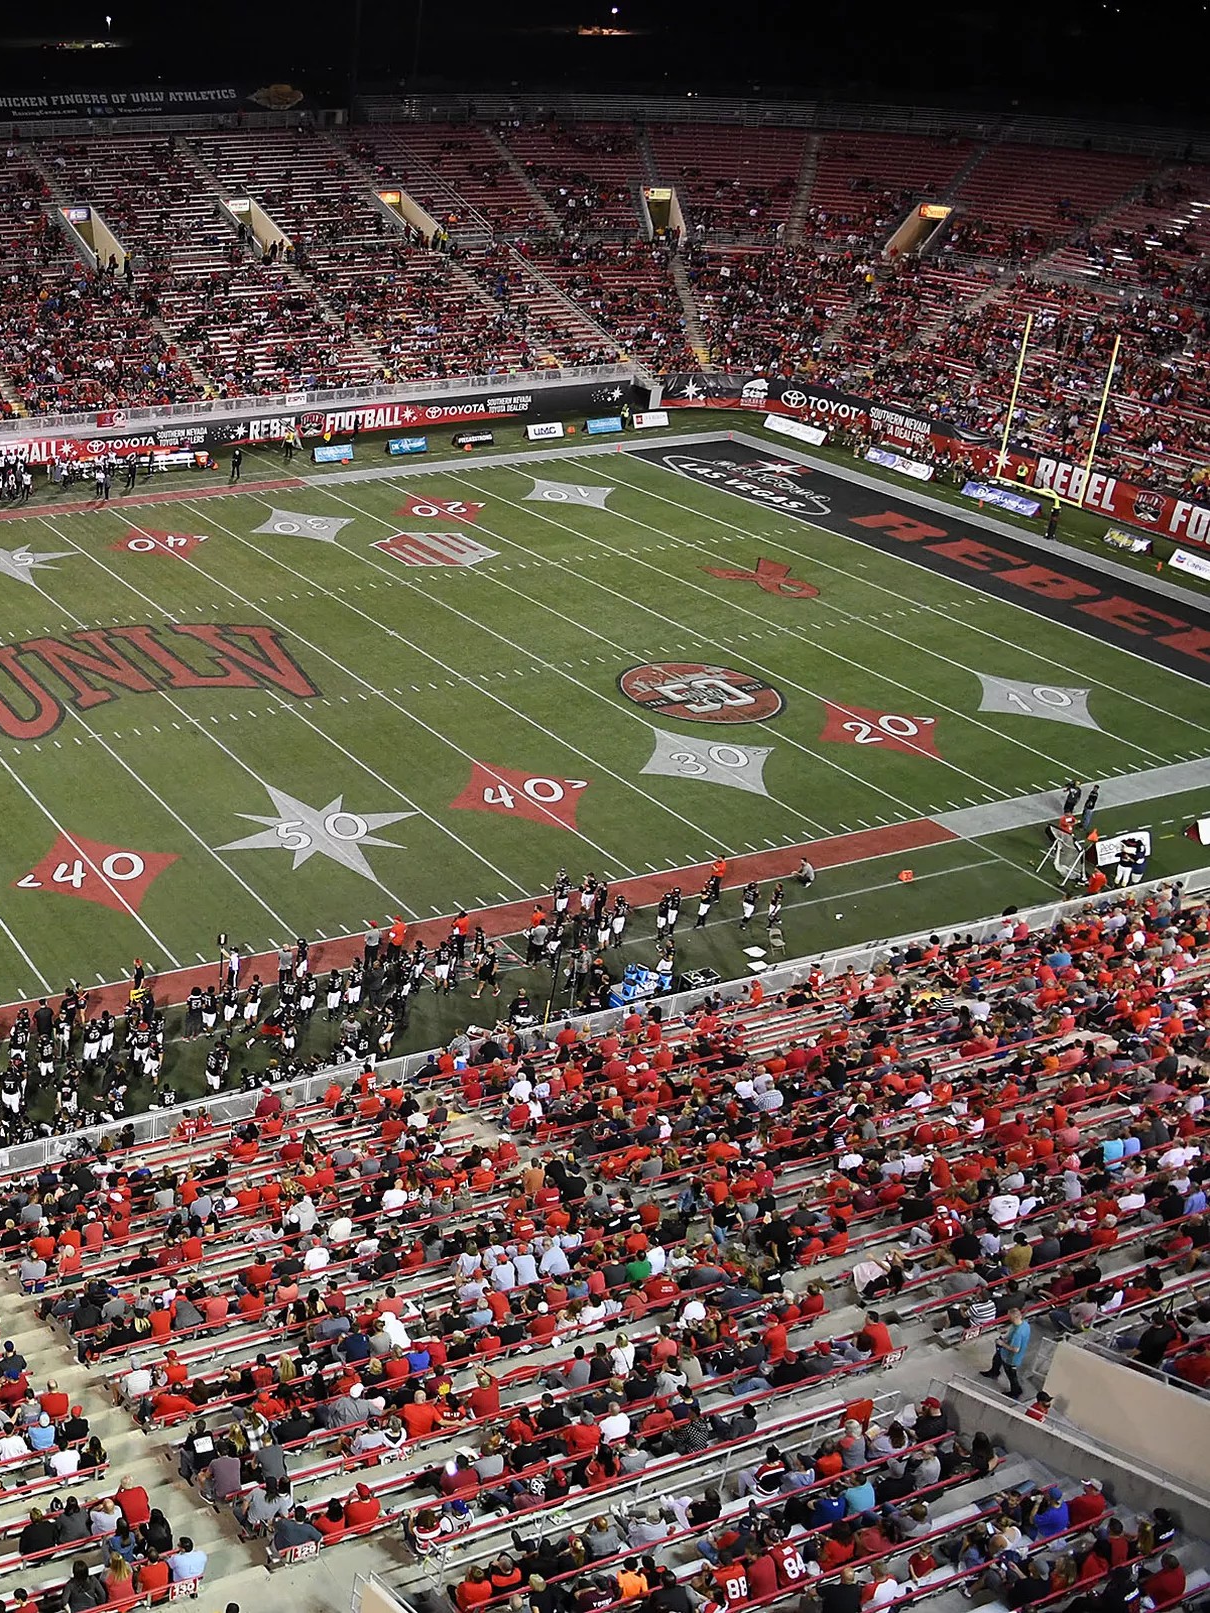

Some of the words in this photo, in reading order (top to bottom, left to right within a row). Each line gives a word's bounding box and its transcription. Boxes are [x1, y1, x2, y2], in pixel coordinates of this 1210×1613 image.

[50, 92, 108, 106] FINGERS
[111, 92, 127, 104] OF
[130, 90, 166, 103] UNLV
[168, 88, 238, 102] ATHLETICS
[325, 406, 402, 432] FOOTBALL
[443, 404, 486, 416] TOYOTA
[870, 406, 902, 428] SOUTHERN
[904, 416, 931, 434] NEVADA
[156, 429, 186, 440] SOUTHERN
[186, 427, 208, 436] NEVADA
[533, 426, 557, 436] UMC
[105, 436, 155, 450] TOYOTA
[678, 463, 729, 480] LAS
[724, 478, 806, 510] VEGAS
[1034, 456, 1117, 512] REBEL
[411, 500, 471, 518] 20
[272, 515, 329, 535] 30
[126, 534, 188, 553] 40
[1006, 686, 1074, 713] 10
[841, 714, 920, 745] 20
[668, 744, 751, 776] 30
[483, 776, 567, 809] 40
[274, 810, 369, 852] 50
[52, 850, 146, 889] 40
[885, 1352, 901, 1364] 129
[296, 1544, 317, 1558] 129
[783, 1557, 806, 1579] 84
[173, 1581, 195, 1597] 130
[726, 1579, 748, 1600] 88
